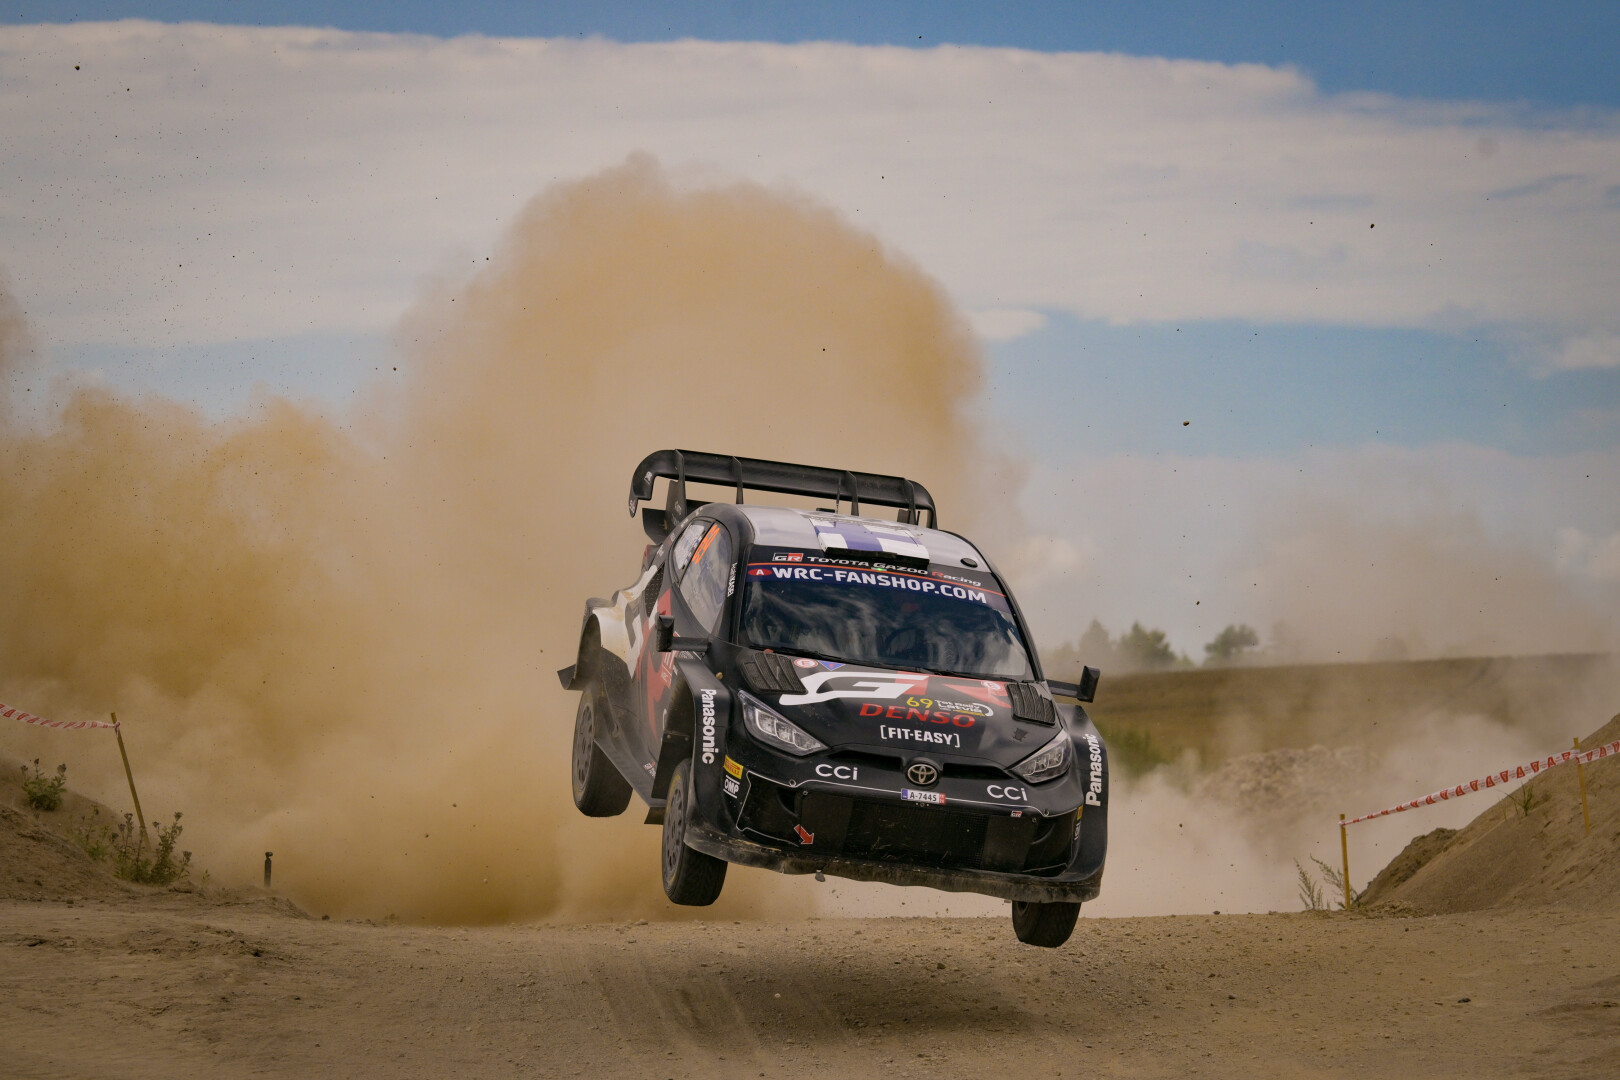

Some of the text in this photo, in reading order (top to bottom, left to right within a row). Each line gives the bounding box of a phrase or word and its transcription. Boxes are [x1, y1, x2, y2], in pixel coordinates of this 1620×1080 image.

[773, 552, 804, 561] GR
[807, 557, 981, 587] TOYOTA GAZOO Racing
[772, 566, 987, 604] WRC-FANSHOP.COM
[906, 697, 933, 708] 69
[700, 688, 719, 764] Panasonic
[859, 703, 975, 728] DENSO
[1082, 733, 1102, 807] Panasonic
[724, 777, 740, 795] OMP
[909, 791, 938, 802] A-7445
